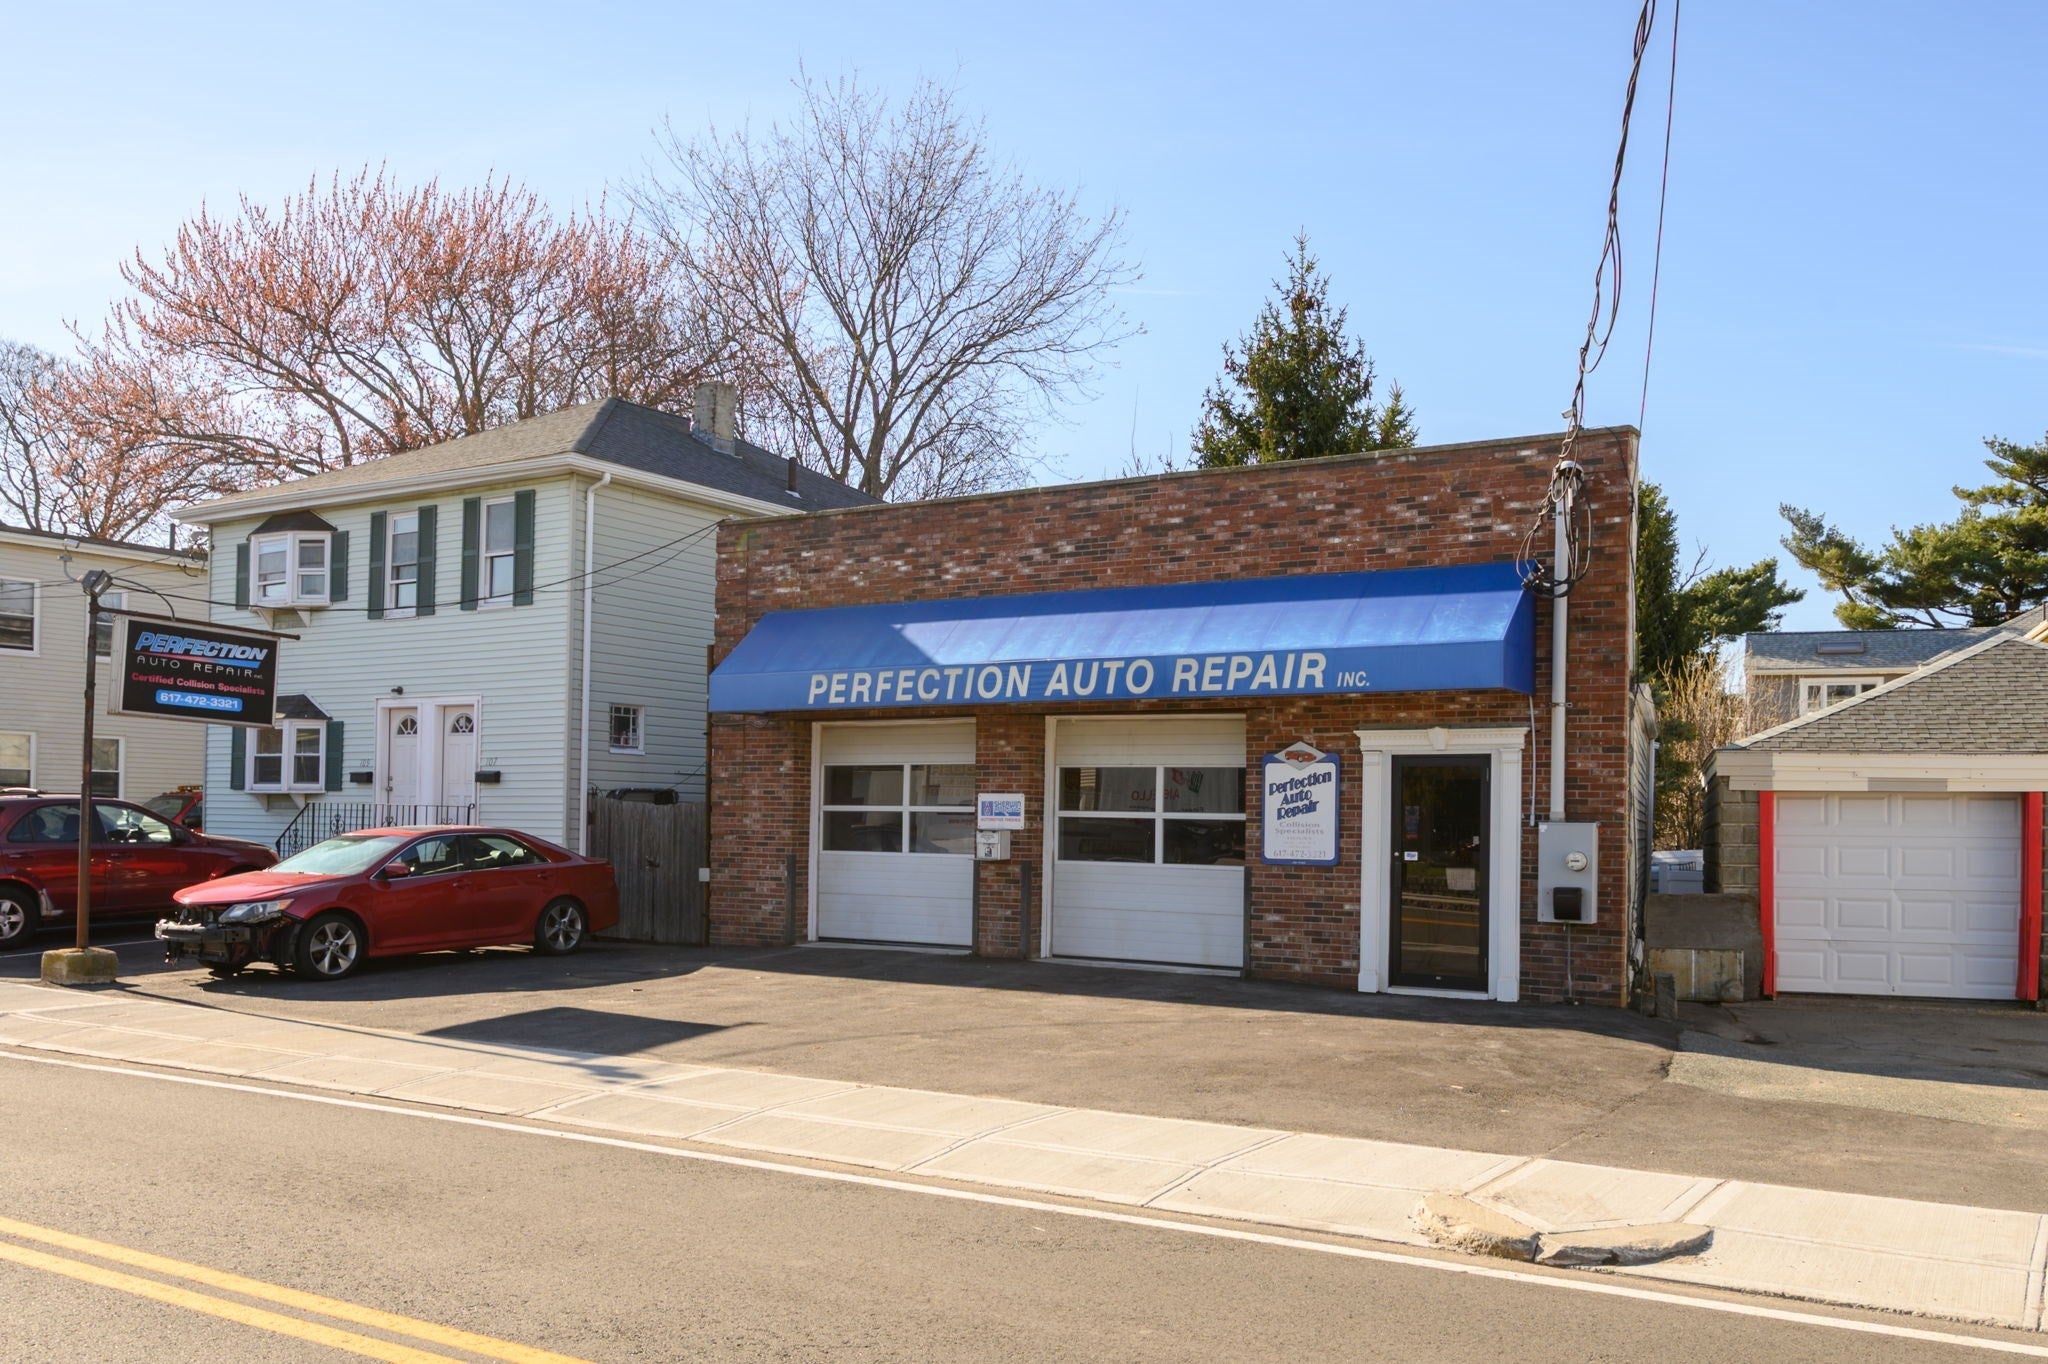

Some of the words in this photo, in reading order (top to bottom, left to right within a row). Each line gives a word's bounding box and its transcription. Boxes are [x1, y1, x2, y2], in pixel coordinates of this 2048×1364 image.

[134, 631, 268, 661] PERFECTION
[136, 655, 181, 669] AUTO
[193, 662, 253, 678] REPAIR
[131, 672, 174, 685] Certified
[176, 677, 215, 690] Collision
[217, 682, 266, 696] Specialists
[808, 664, 1032, 705] PERFECTION
[1044, 658, 1155, 697] AUTO
[1172, 652, 1327, 693] REPAIR
[1336, 671, 1371, 688] INC.
[160, 692, 238, 709] 617-472-3321
[1268, 771, 1332, 796] Perfection
[1280, 789, 1313, 807] Auto
[1276, 800, 1320, 820] Repair
